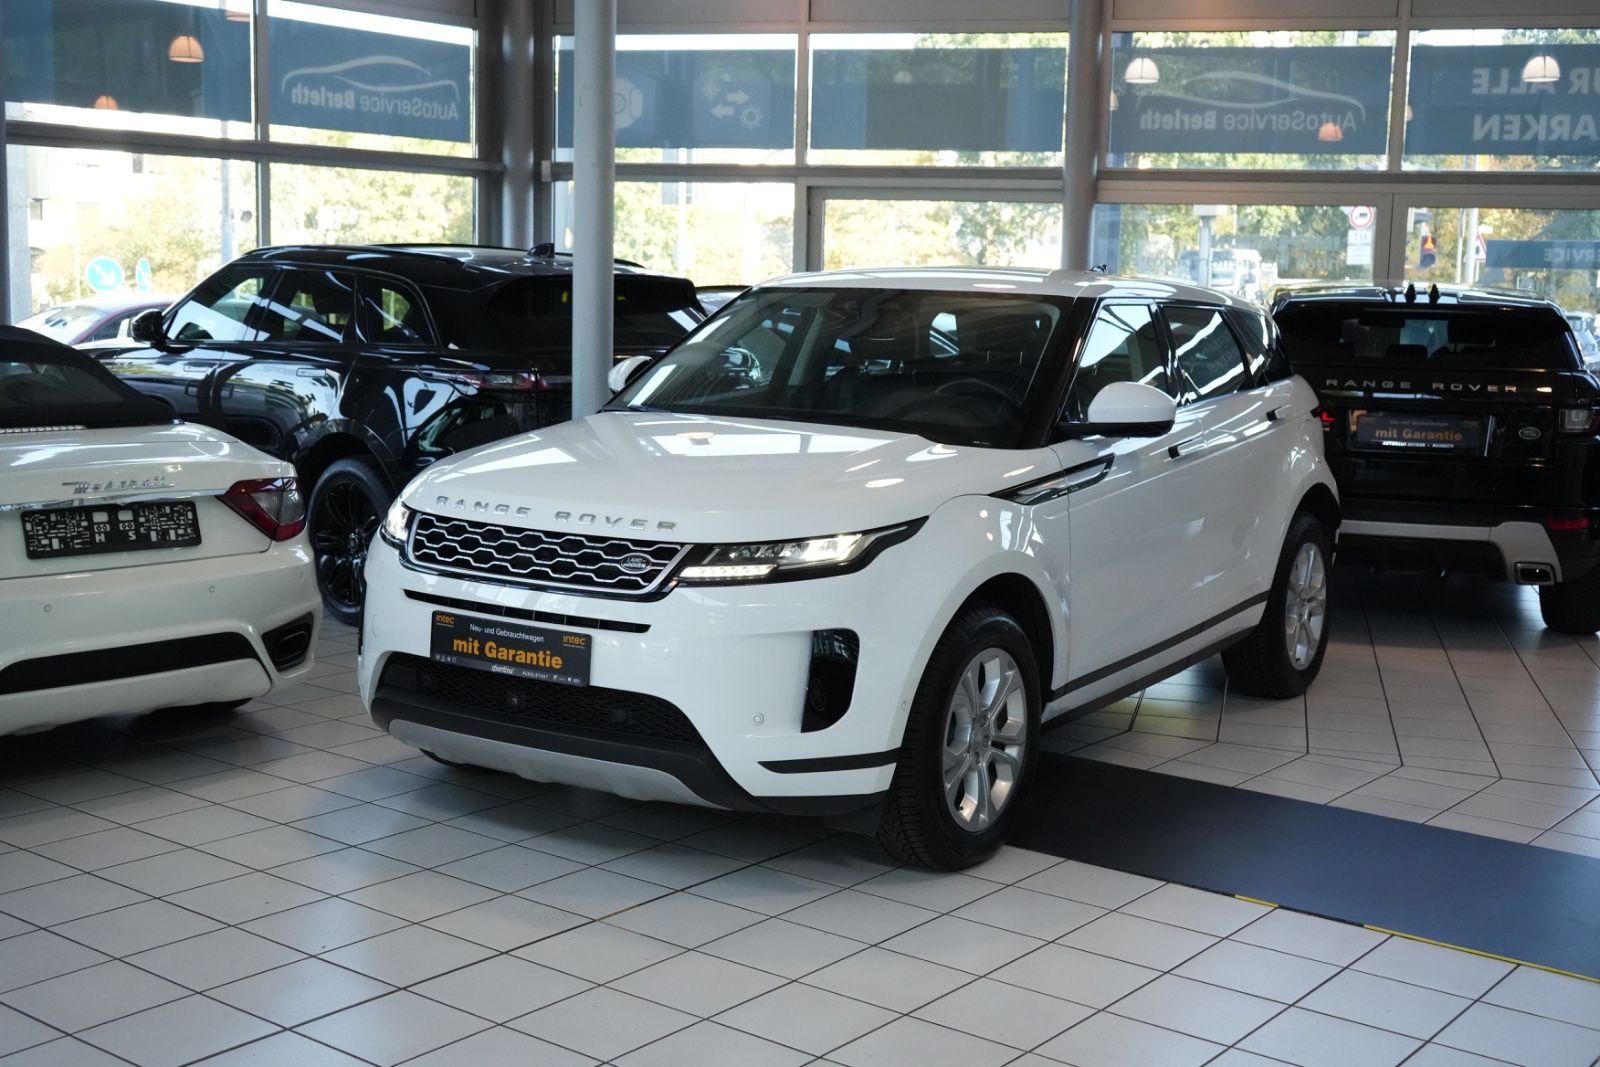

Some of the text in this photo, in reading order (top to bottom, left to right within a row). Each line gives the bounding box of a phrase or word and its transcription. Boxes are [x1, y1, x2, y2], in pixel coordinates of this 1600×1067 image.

[1326, 378, 1517, 393] RANGE ROVER
[1375, 427, 1462, 441] mit Garantie
[435, 495, 677, 533] RANGE ROVER
[435, 614, 455, 625] intec
[484, 627, 495, 635] und
[495, 627, 545, 643] Gebrauchtwagen
[562, 634, 586, 646] intec
[453, 637, 563, 669] mit Garantie
